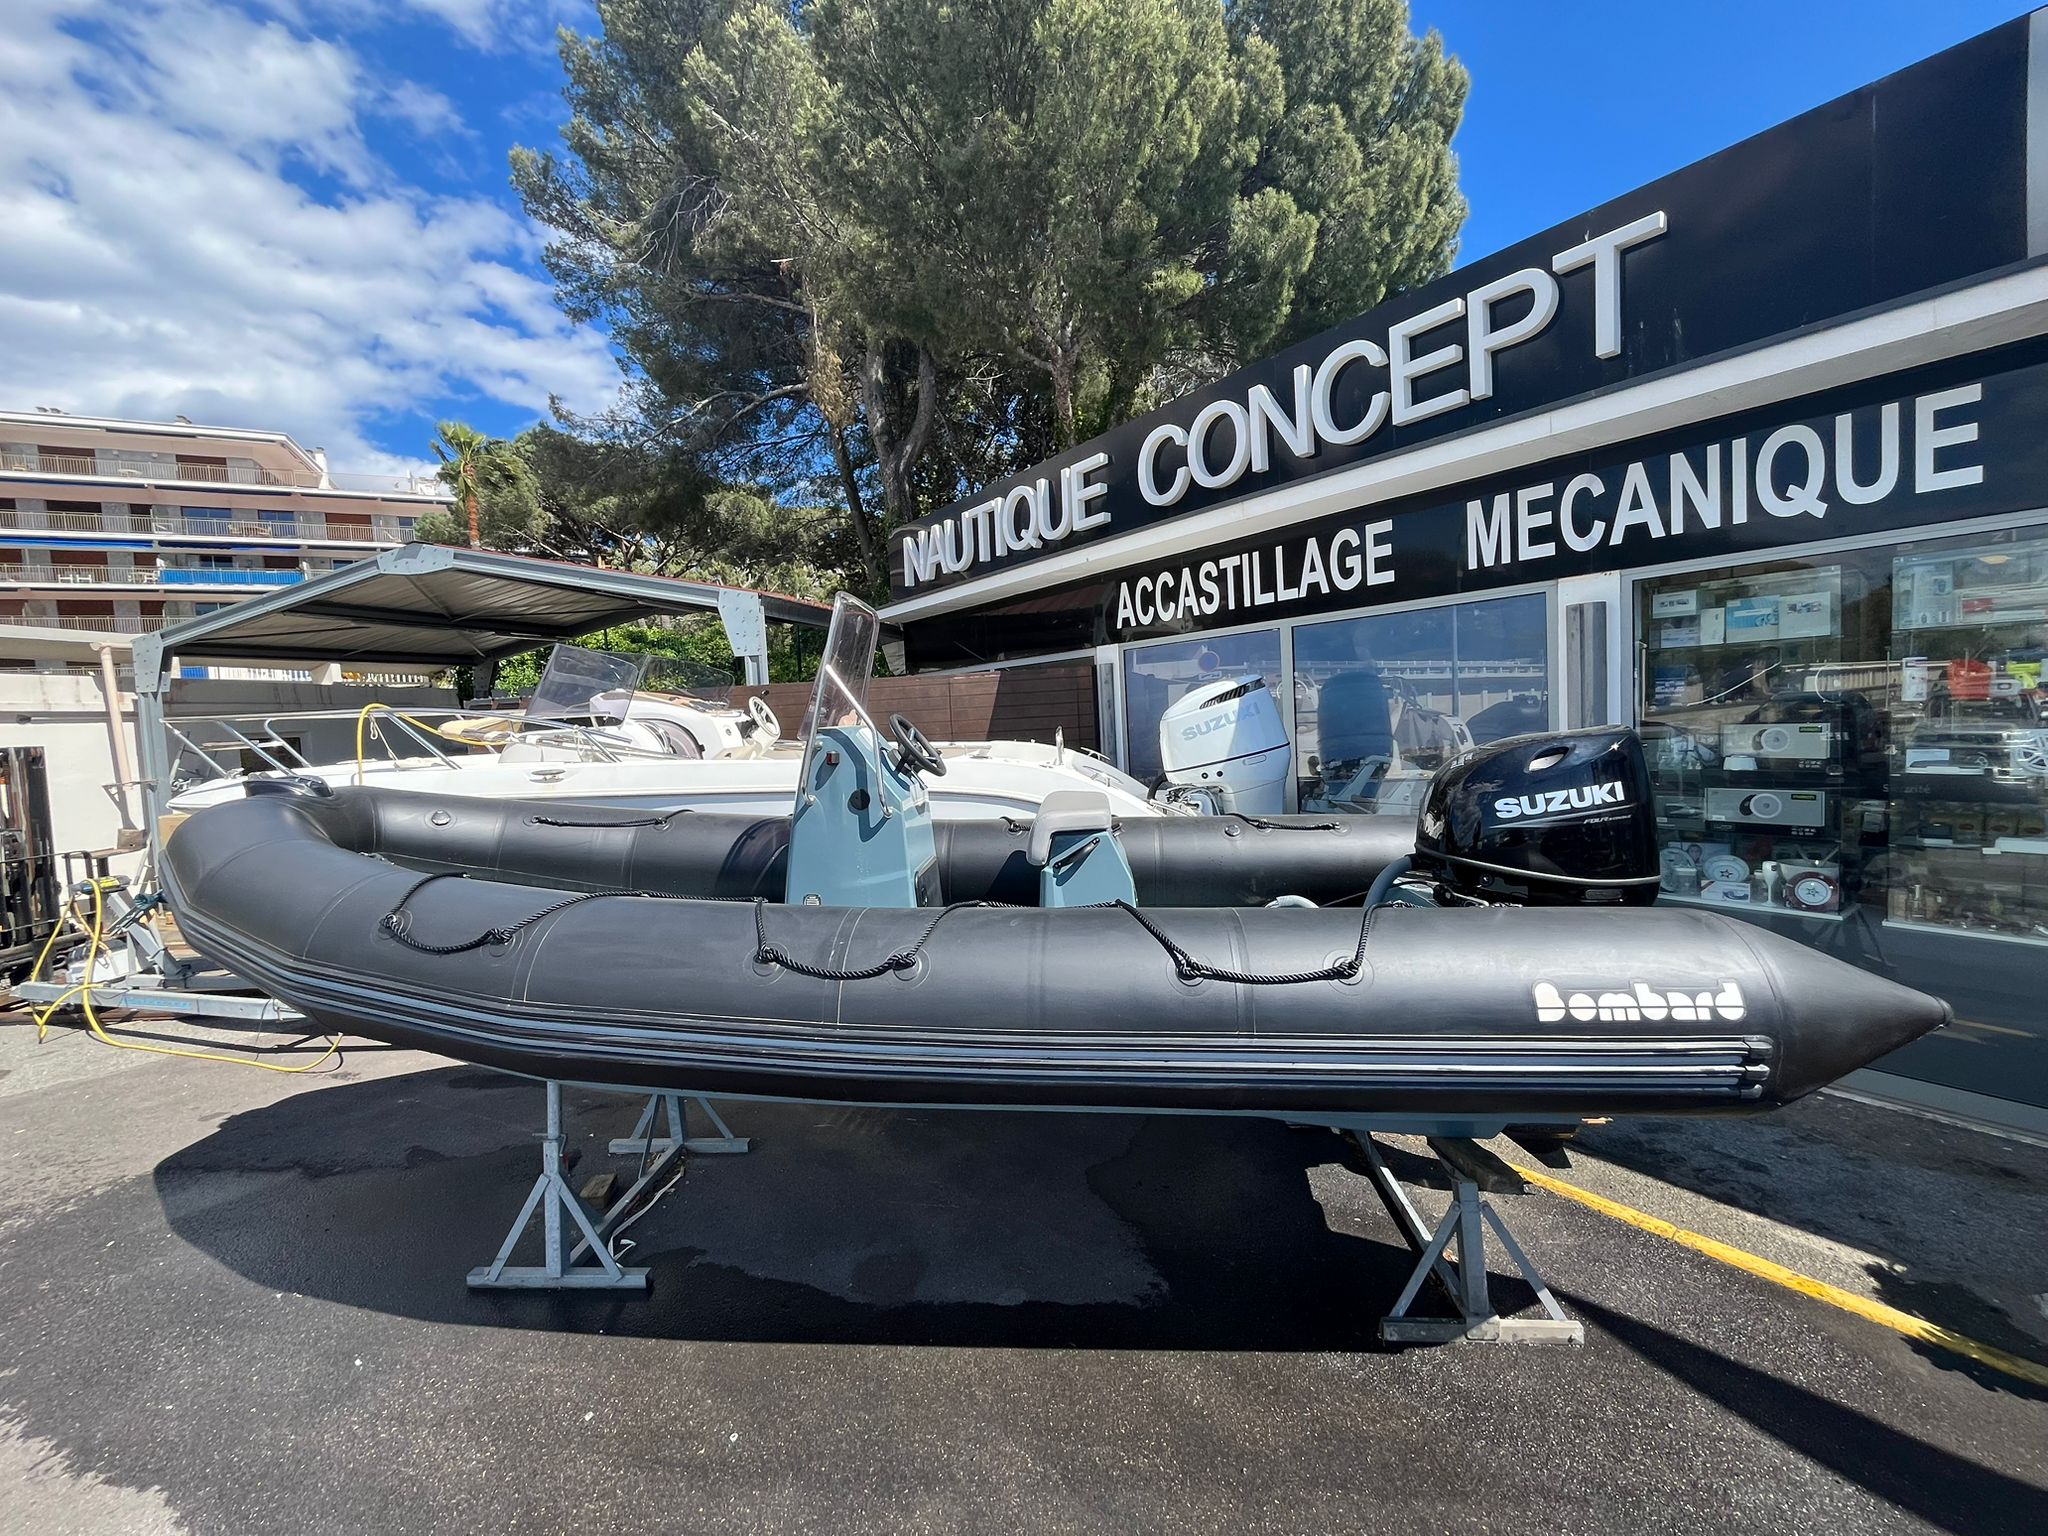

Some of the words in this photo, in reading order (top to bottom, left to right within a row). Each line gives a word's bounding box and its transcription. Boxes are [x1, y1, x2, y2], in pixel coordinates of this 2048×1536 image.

[903, 452, 1111, 587] NAUTIQUE
[1138, 210, 1667, 506] CONCEPT
[1116, 519, 1395, 629] ACCASTILLAGE
[1466, 383, 1984, 571] MECANIQUE
[1181, 701, 1261, 741] SUZUKI
[1494, 780, 1625, 819] SUZUKI
